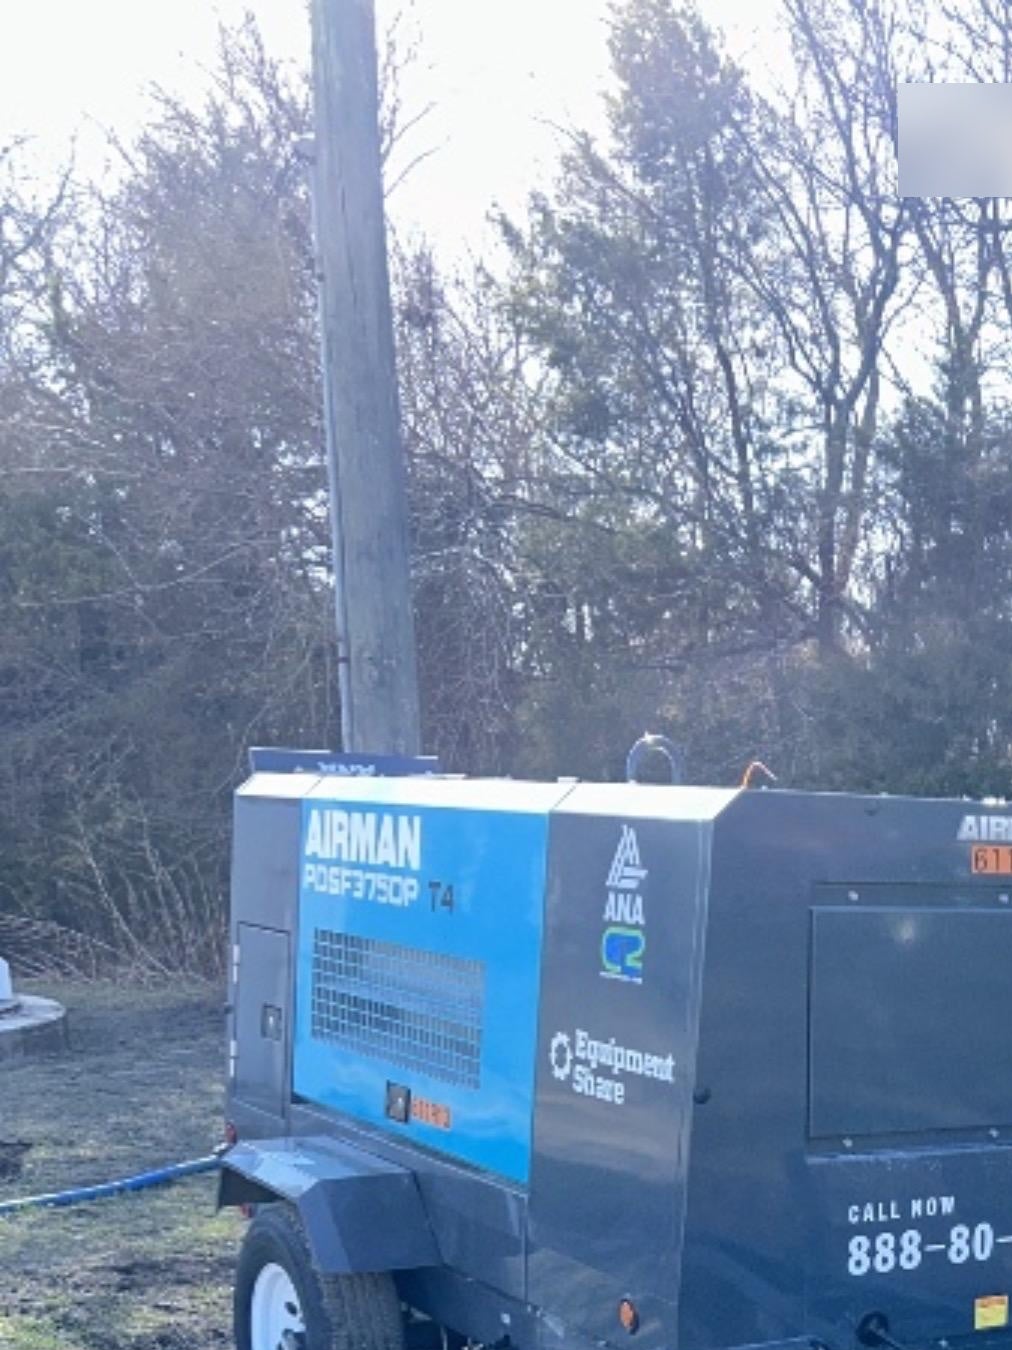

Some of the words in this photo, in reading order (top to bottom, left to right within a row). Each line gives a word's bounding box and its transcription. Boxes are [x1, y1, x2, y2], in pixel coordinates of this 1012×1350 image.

[305, 808, 422, 871] AIRMAN
[428, 880, 455, 915] T4
[603, 891, 646, 925] ANA
[575, 1028, 676, 1084] Equipment
[572, 1063, 625, 1105] Share
[848, 1203, 901, 1224] CALL
[910, 1196, 956, 1219] NOW
